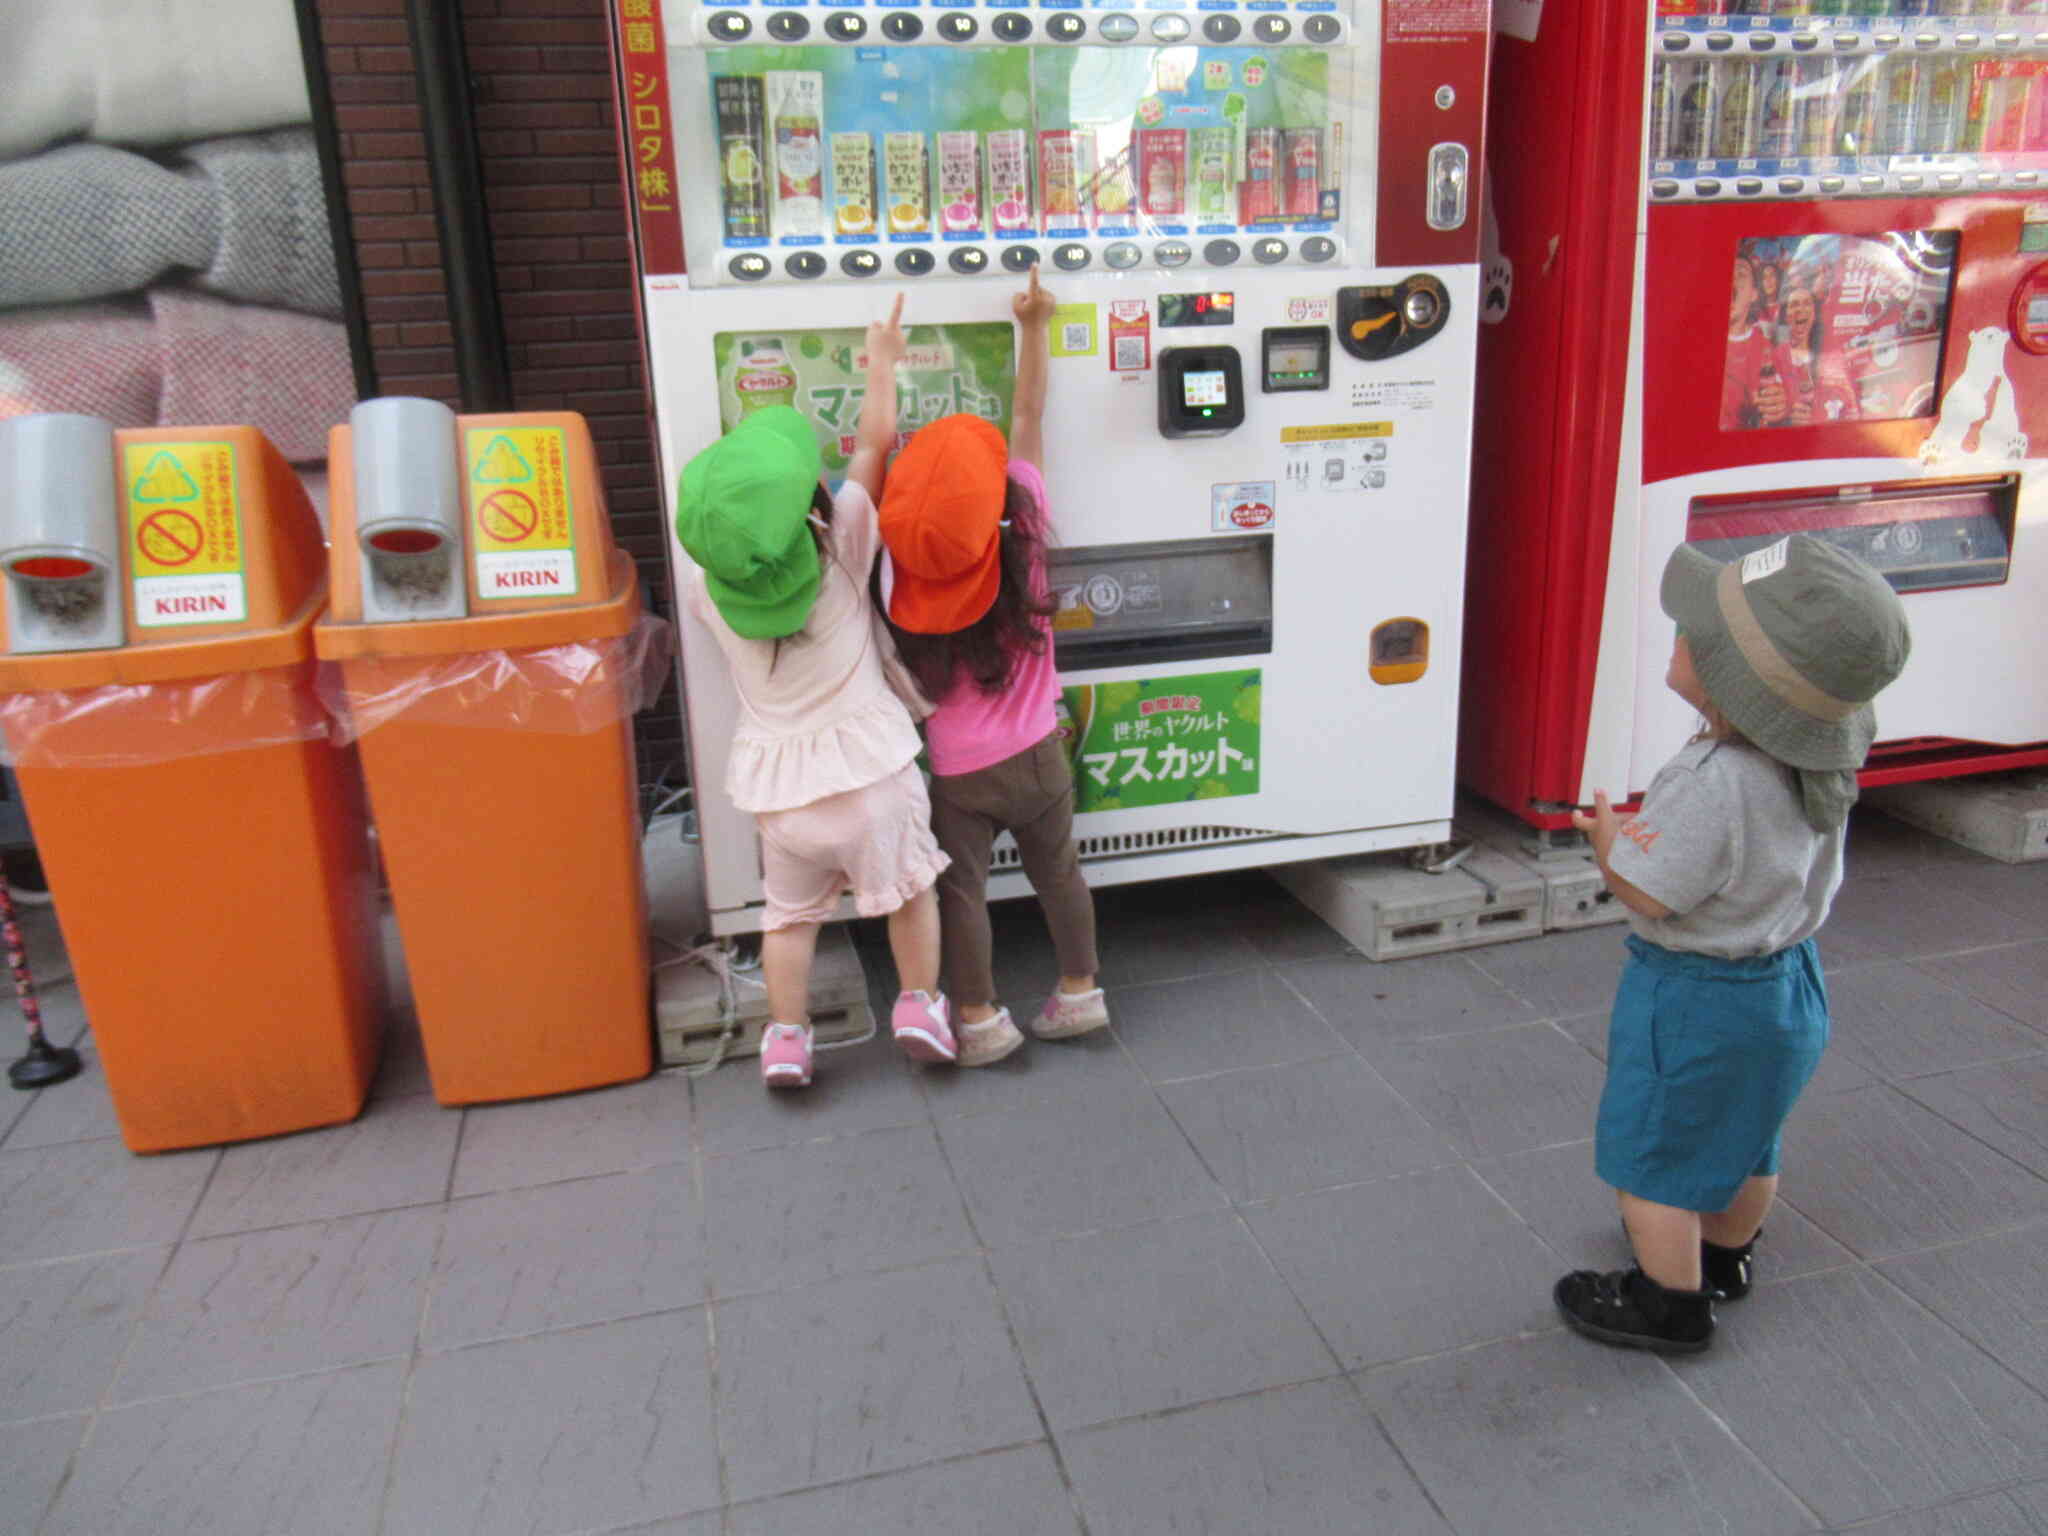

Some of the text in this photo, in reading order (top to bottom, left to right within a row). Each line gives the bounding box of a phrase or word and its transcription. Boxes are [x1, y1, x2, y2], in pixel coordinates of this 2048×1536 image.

[495, 570, 560, 588] KIRIN
[154, 595, 227, 615] KIRIN
[1113, 711, 1230, 742] 世界のヤクルト
